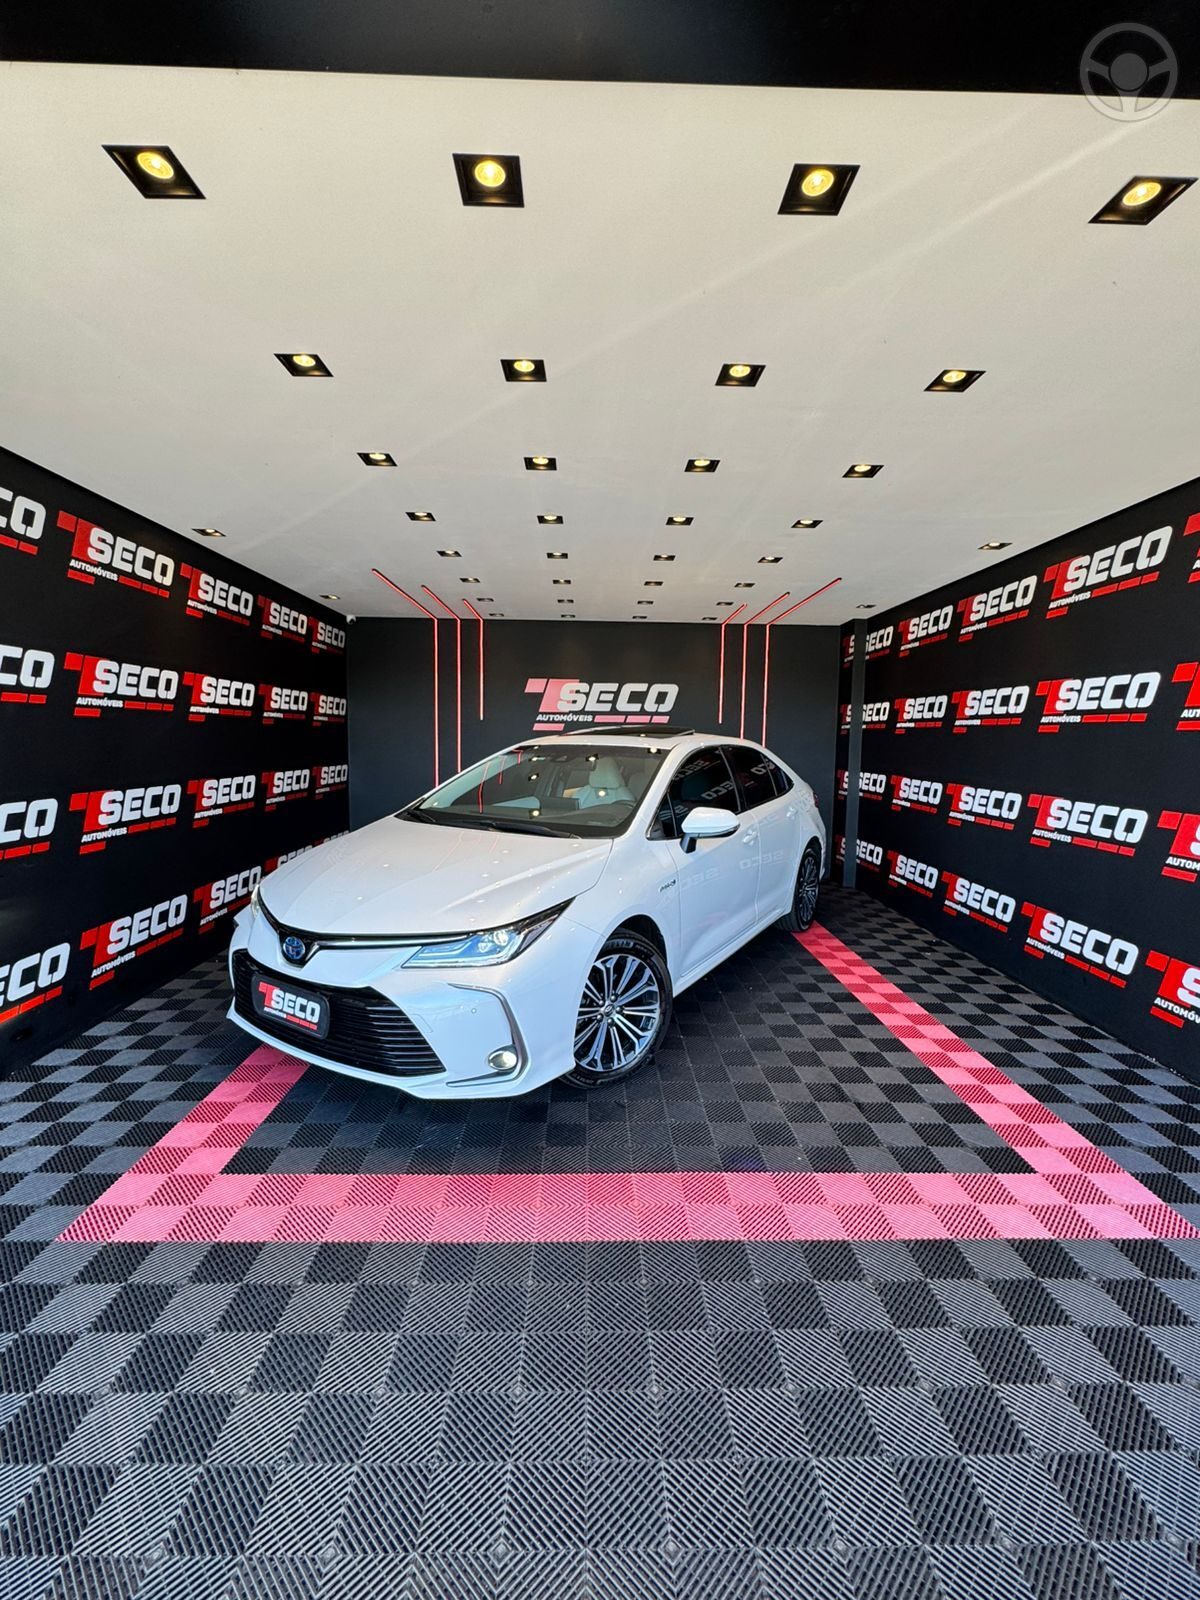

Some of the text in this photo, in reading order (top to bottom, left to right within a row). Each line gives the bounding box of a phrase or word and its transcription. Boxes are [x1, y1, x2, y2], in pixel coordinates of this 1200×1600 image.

[69, 559, 118, 582] AUTOMÓVEIS
[1049, 590, 1091, 609] AUTOMÓVEIS
[76, 697, 123, 708] AUTOMÓVEIS
[536, 712, 593, 722] AUTOMÓVEIS
[1040, 713, 1081, 723] AUTOMÓVEIS
[81, 827, 127, 843] AUTOMÓVEIS
[1032, 828, 1072, 844] AUTOMÓVEIS
[1165, 856, 1200, 871] AUTOM
[1026, 937, 1065, 960] AUTOMÓVEIS
[91, 950, 136, 978] AUTOMÓVEIS
[1153, 996, 1200, 1024] AUTOMÓV
